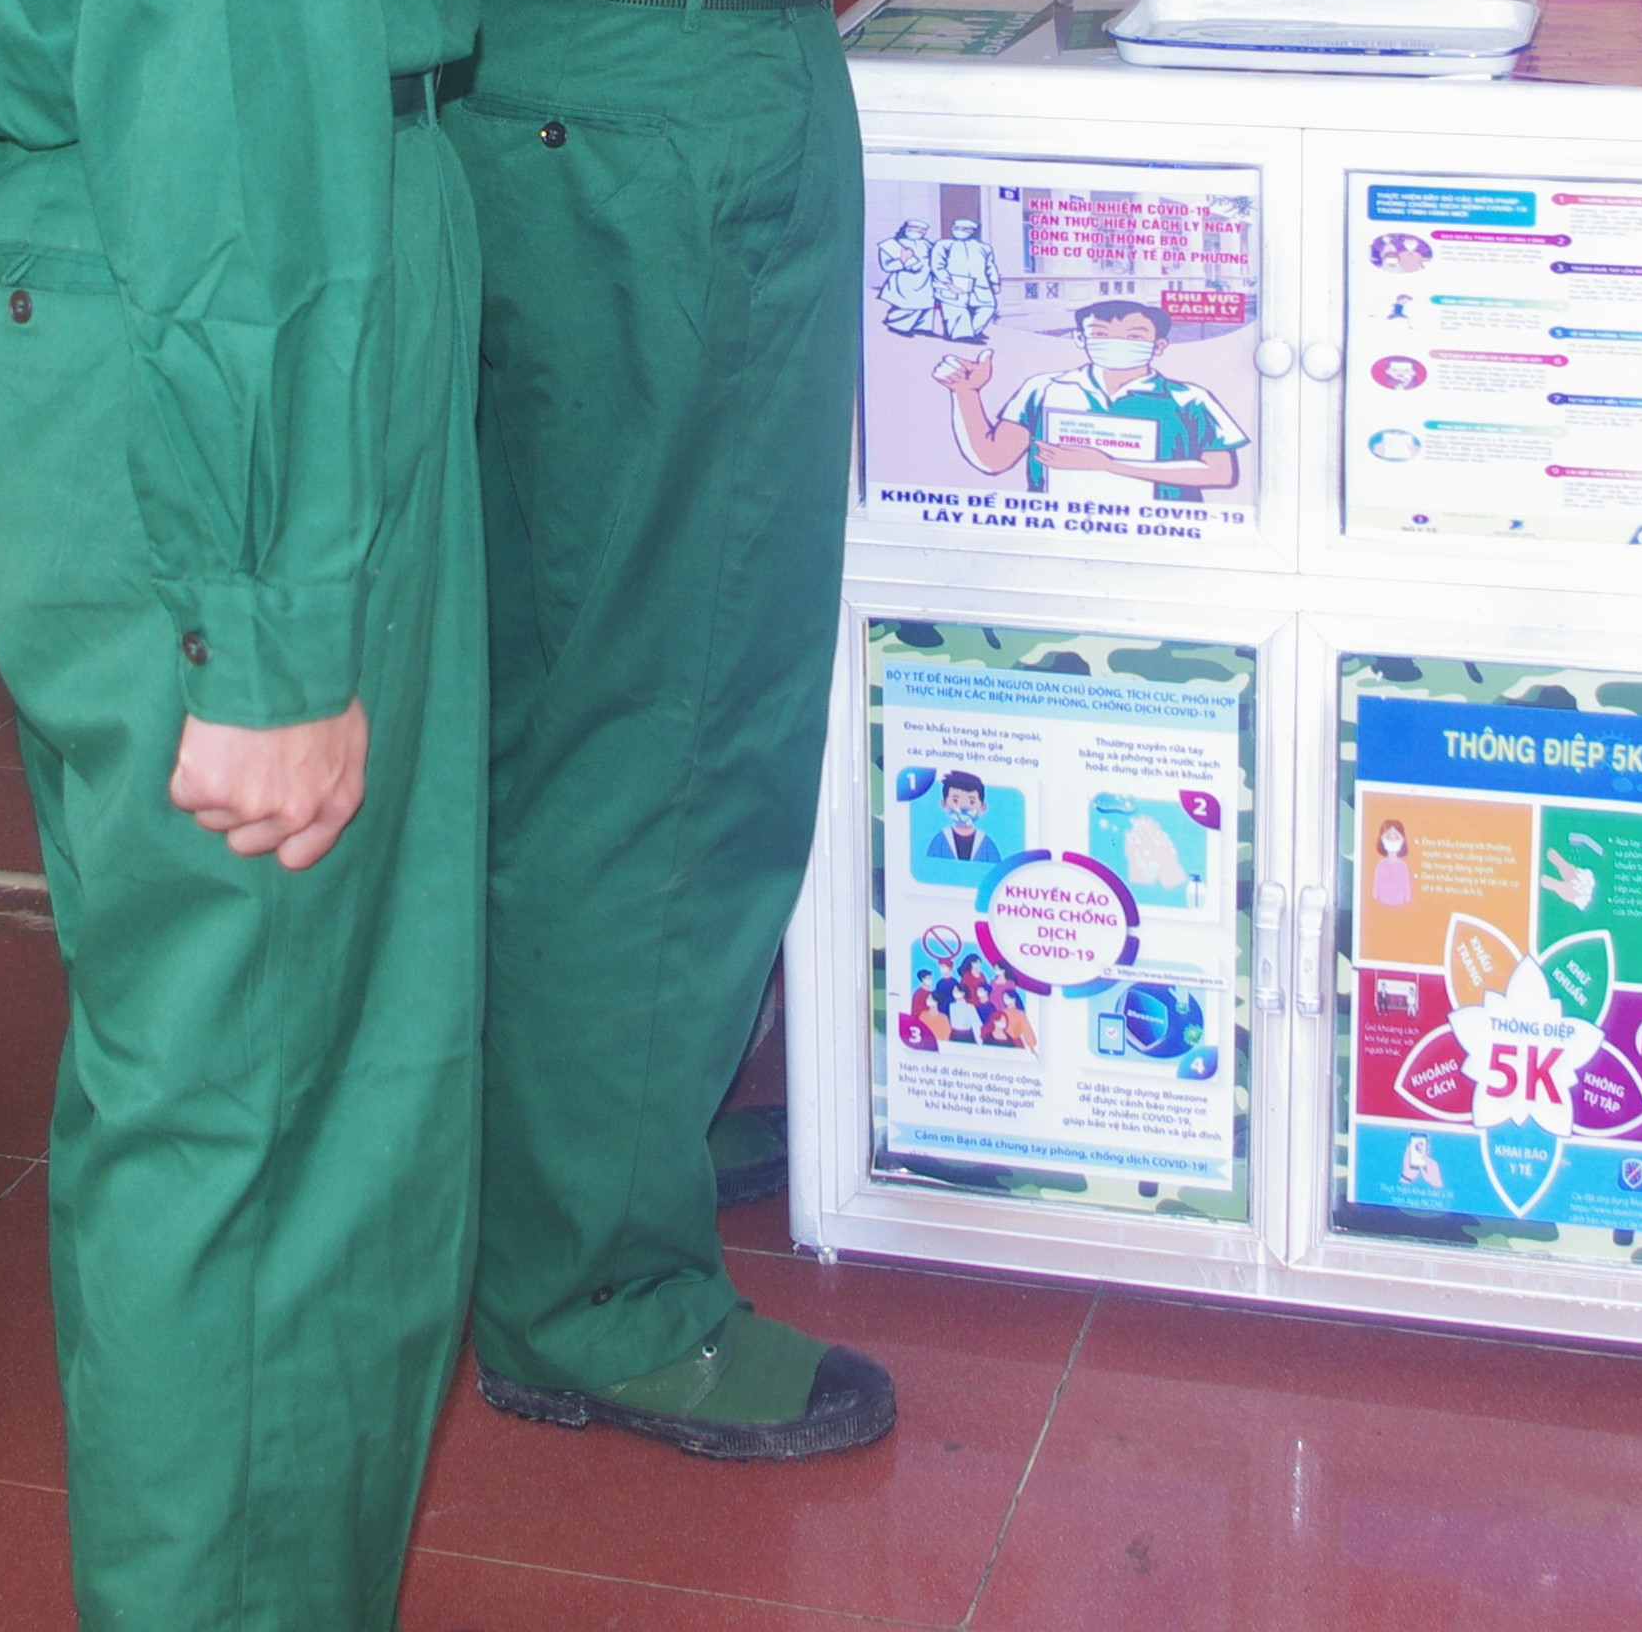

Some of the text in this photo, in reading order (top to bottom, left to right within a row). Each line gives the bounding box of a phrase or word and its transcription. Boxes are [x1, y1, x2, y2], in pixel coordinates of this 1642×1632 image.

[1166, 293, 1241, 305] KHU VỰC
[1168, 303, 1239, 315] CÁCH LY
[1059, 435, 1141, 449] VIRUS CORONA
[881, 489, 1245, 524] KHÔNG ĐỂ DỊCH BỆNH COVID-19
[923, 508, 1202, 539] LÂY LAN RA CỘNG ĐỒNG
[886, 669, 1235, 708] BỘ Y TẾ ĐỀ NGHỊ MỖI NGƯỜI DÂN CHỦ ĐỘNG, TÍCH CỰC, PHỐI HỢP
[906, 684, 1216, 718] THỰC HIỆN CÁC BIỆN PHÁP PHÒNG, CHỐNG DỊCH COVID-19
[1443, 725, 1536, 765] THÔNG
[1543, 731, 1605, 774] ĐIỆP
[906, 773, 917, 791] 1
[1192, 797, 1207, 816] 2
[1005, 885, 1109, 906] KHUYẾN CÁO
[997, 903, 1117, 926] PHÒNG CHỐNG
[1037, 926, 1076, 942] DỊCH
[1019, 943, 1094, 961] COVID-19
[1456, 942, 1484, 988] TRANG
[1566, 958, 1592, 986] KHỬ
[909, 1027, 923, 1043] 3
[1489, 1016, 1575, 1042] THÔNG ĐIỆP
[1190, 1057, 1205, 1074] 4
[1486, 1043, 1565, 1105] 5K
[1583, 1071, 1625, 1099] KHÔNG
[1583, 1088, 1621, 1114] TỤ TẬP
[914, 1129, 1208, 1172] Cảm ơn Bạn đã chung tay phòng, chống dịch COVID-19!
